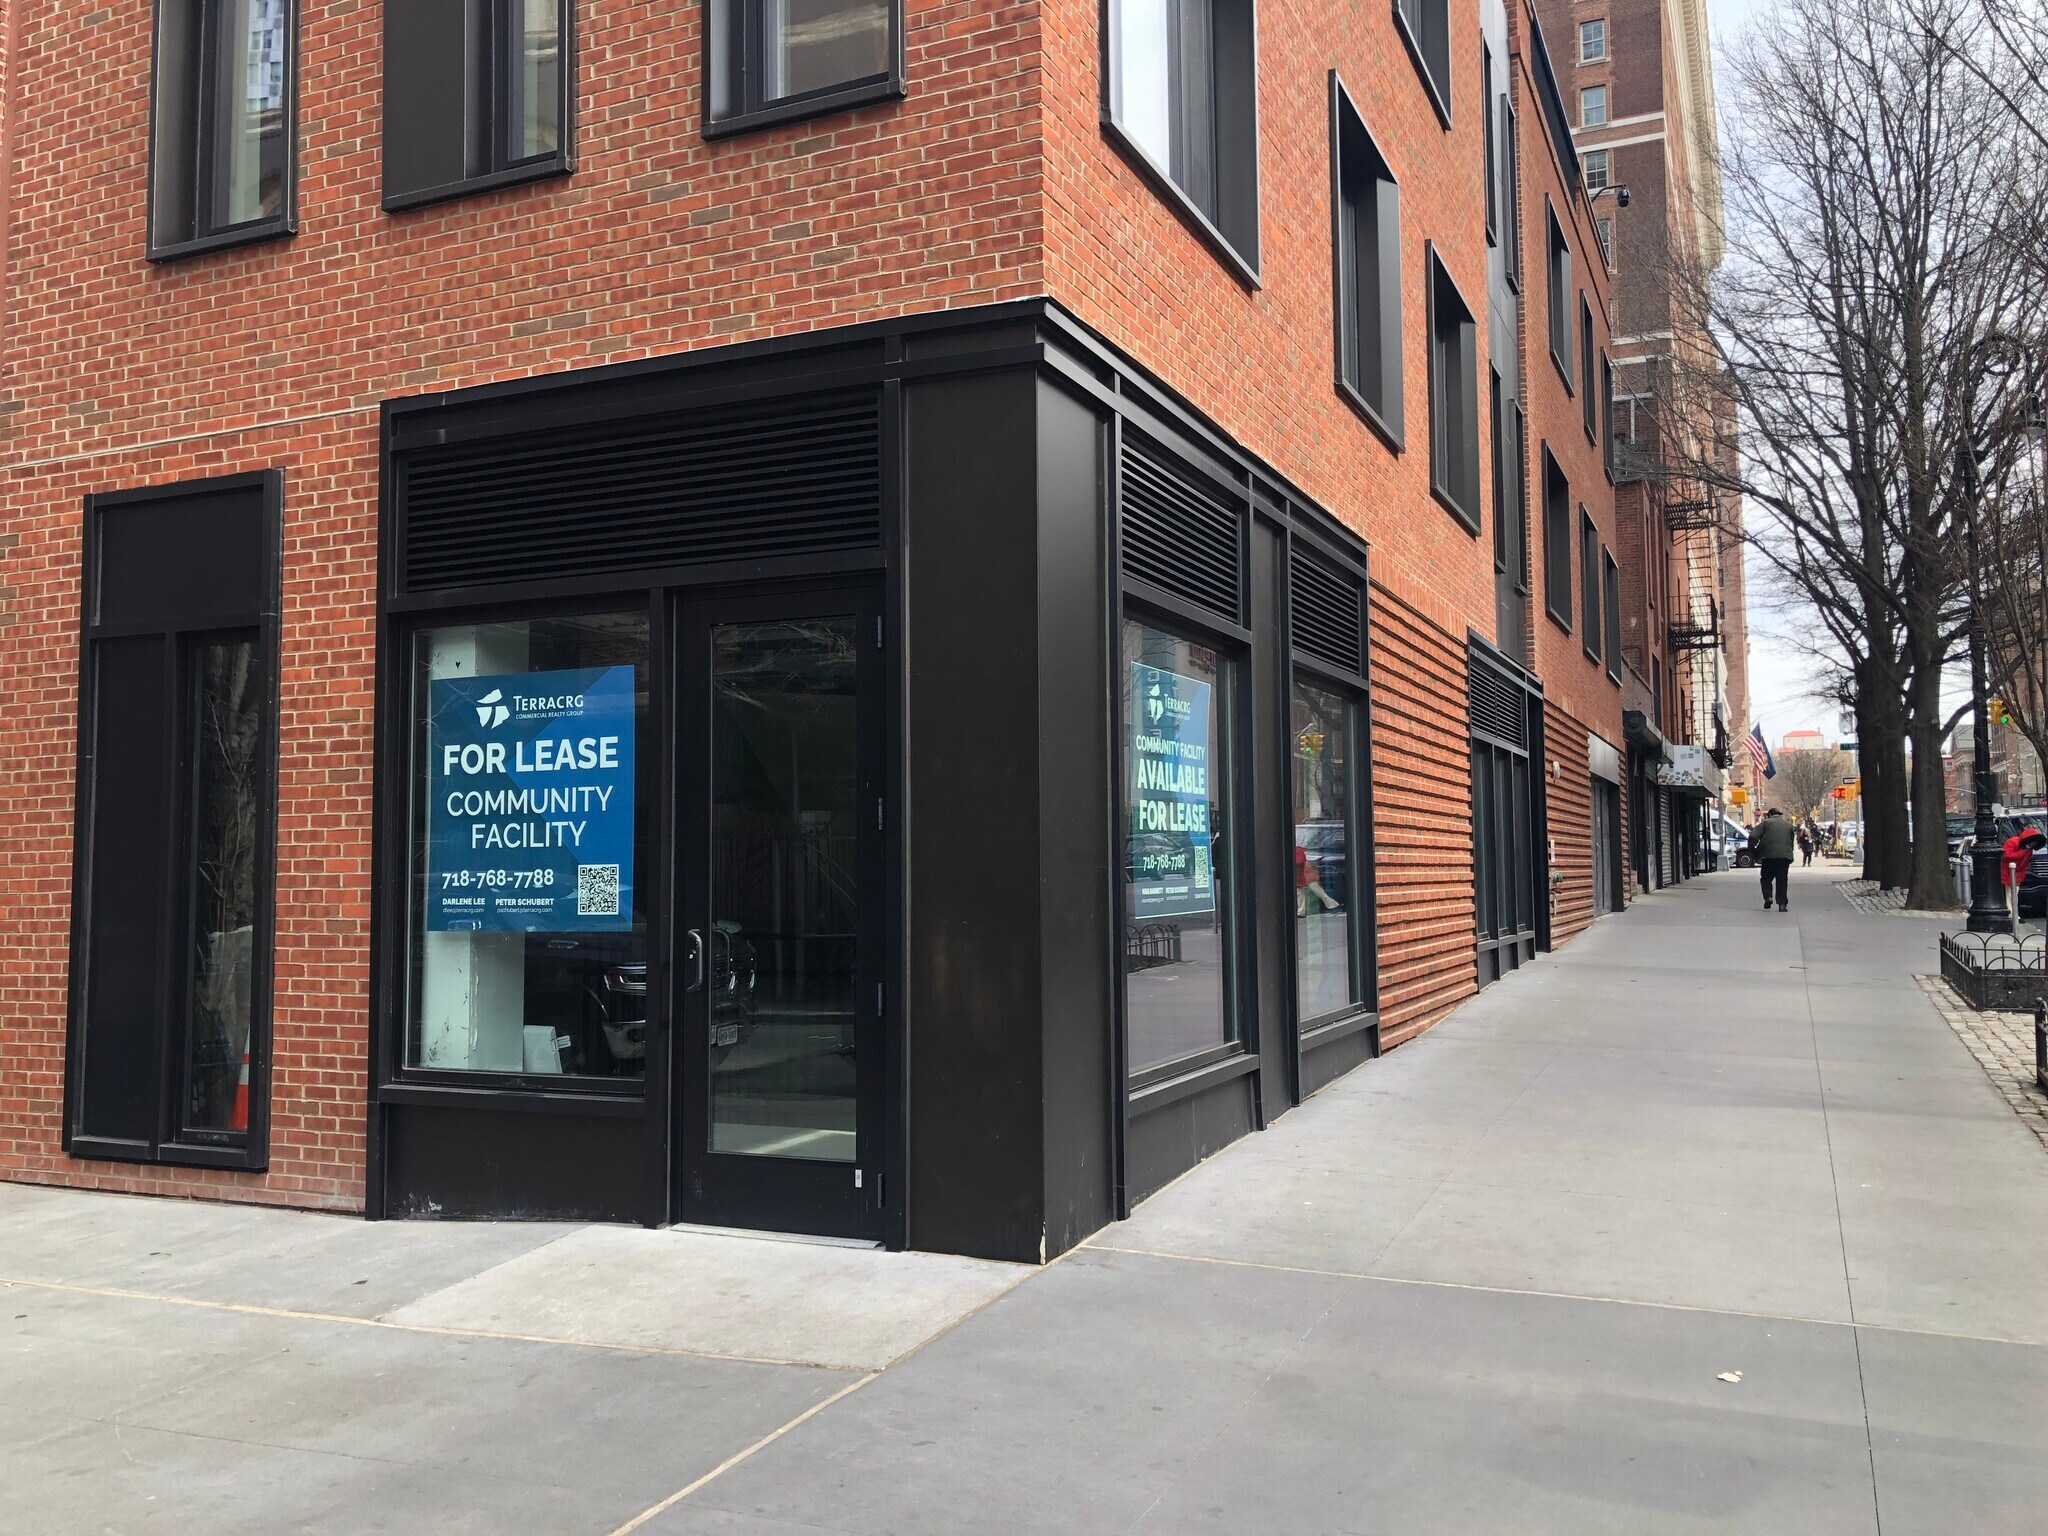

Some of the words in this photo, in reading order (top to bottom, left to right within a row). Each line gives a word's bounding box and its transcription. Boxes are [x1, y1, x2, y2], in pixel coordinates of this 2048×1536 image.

[512, 694, 584, 712] TERRACRG
[515, 712, 548, 720] COMMERCIAL
[443, 742, 507, 776] FOR
[515, 736, 619, 773] LEASE
[1136, 734, 1180, 757] COMMUNITY
[1180, 742, 1205, 761] FACILITY
[1136, 758, 1205, 795] AVAILABLE
[446, 785, 613, 817] COMMUNITY
[1139, 799, 1167, 832] FOR
[1170, 802, 1206, 832] LEASE
[471, 821, 587, 849] FACILITY
[1142, 853, 1186, 872] 718-768-7788
[441, 868, 554, 890] 718-768-7788
[442, 897, 473, 905] DARLENE
[473, 897, 485, 905] LEE
[495, 898, 516, 906] PETER
[517, 898, 555, 906] SCHUBERT
